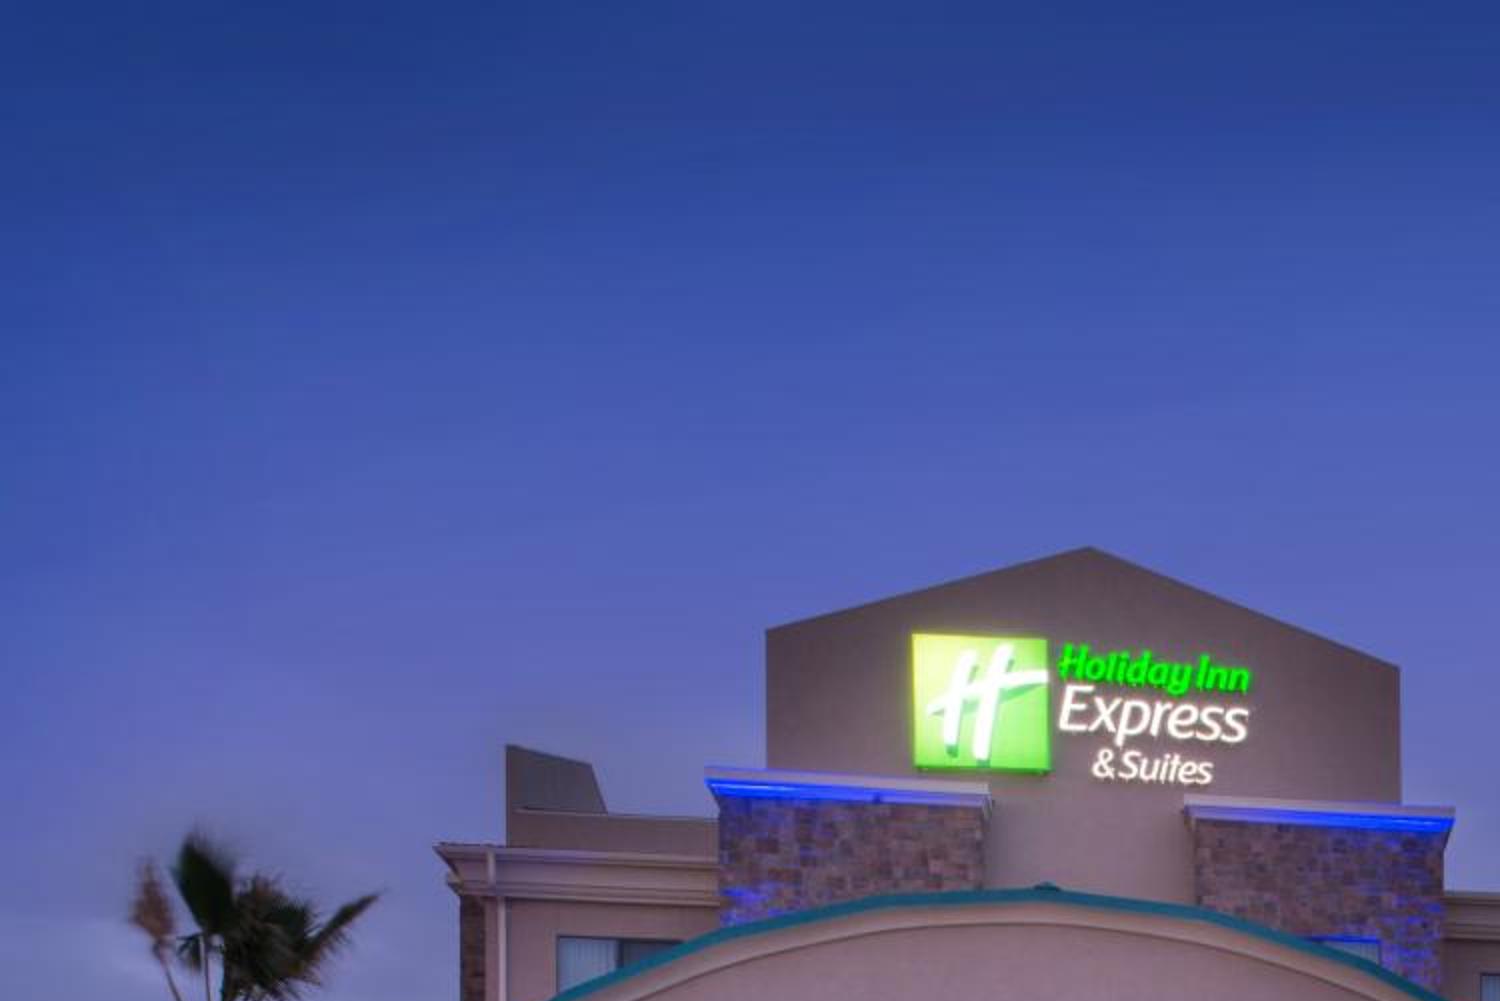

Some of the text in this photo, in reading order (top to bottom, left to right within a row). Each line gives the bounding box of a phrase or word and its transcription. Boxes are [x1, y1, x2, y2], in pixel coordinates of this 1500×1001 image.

[1057, 643, 1250, 695] Holiday Inn
[1058, 684, 1250, 746] Express
[1091, 748, 1215, 785] & Suites
